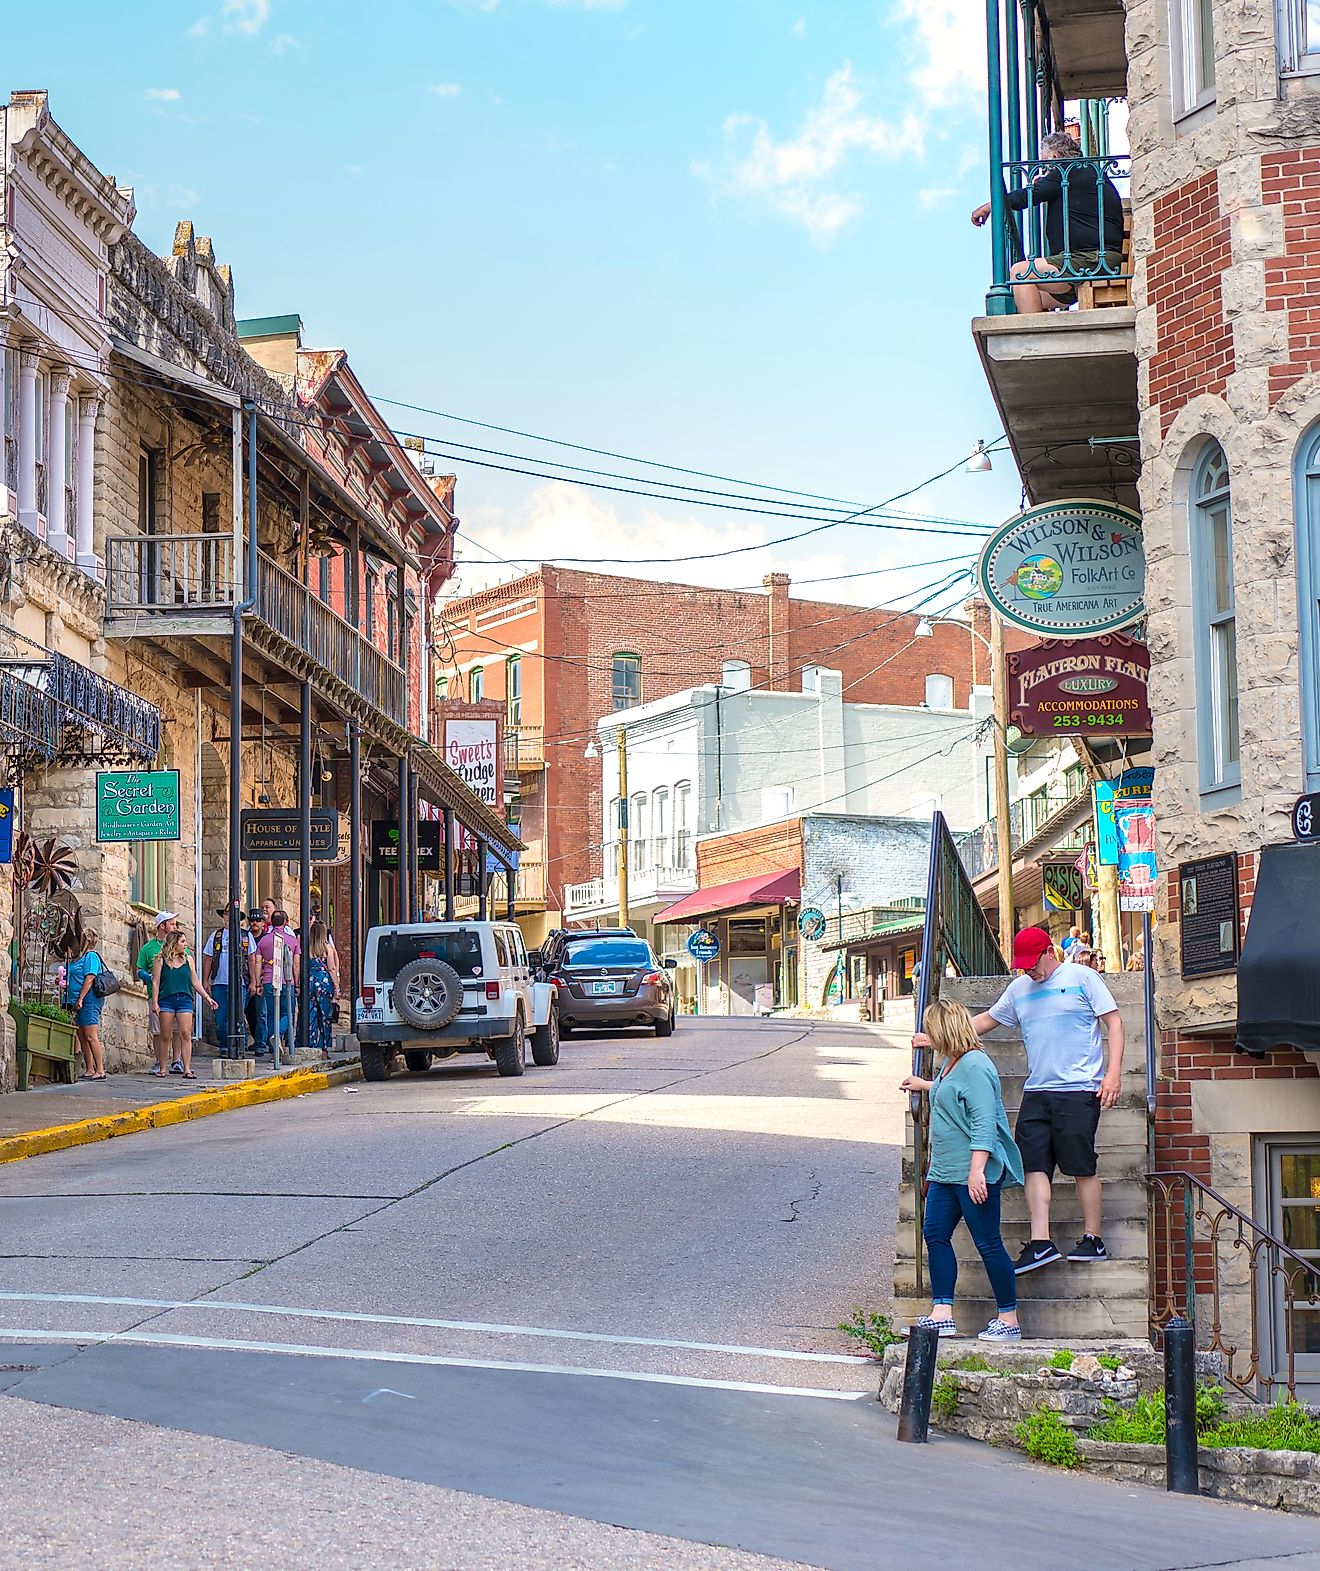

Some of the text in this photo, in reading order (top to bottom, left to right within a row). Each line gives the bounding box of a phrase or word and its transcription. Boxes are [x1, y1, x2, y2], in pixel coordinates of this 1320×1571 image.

[1007, 519, 1106, 556] WILSON &
[1053, 537, 1138, 566] WILSON
[1033, 598, 1118, 613] TRUE AMERICANA ART
[1017, 655, 1102, 707] FLATIRON
[1064, 678, 1113, 690] LUXURY
[1038, 700, 1139, 712] ACCOMMODATIONS
[1053, 713, 1124, 727] 253-9434
[450, 739, 492, 766] Sweet's
[125, 774, 141, 784] The
[102, 782, 153, 799] Secret
[116, 799, 175, 819] Garden
[101, 830, 121, 838] Jewelry
[247, 823, 281, 834] HOUSE
[285, 824, 297, 833] OF
[289, 839, 326, 847] UNUES
[379, 847, 398, 856] TEE
